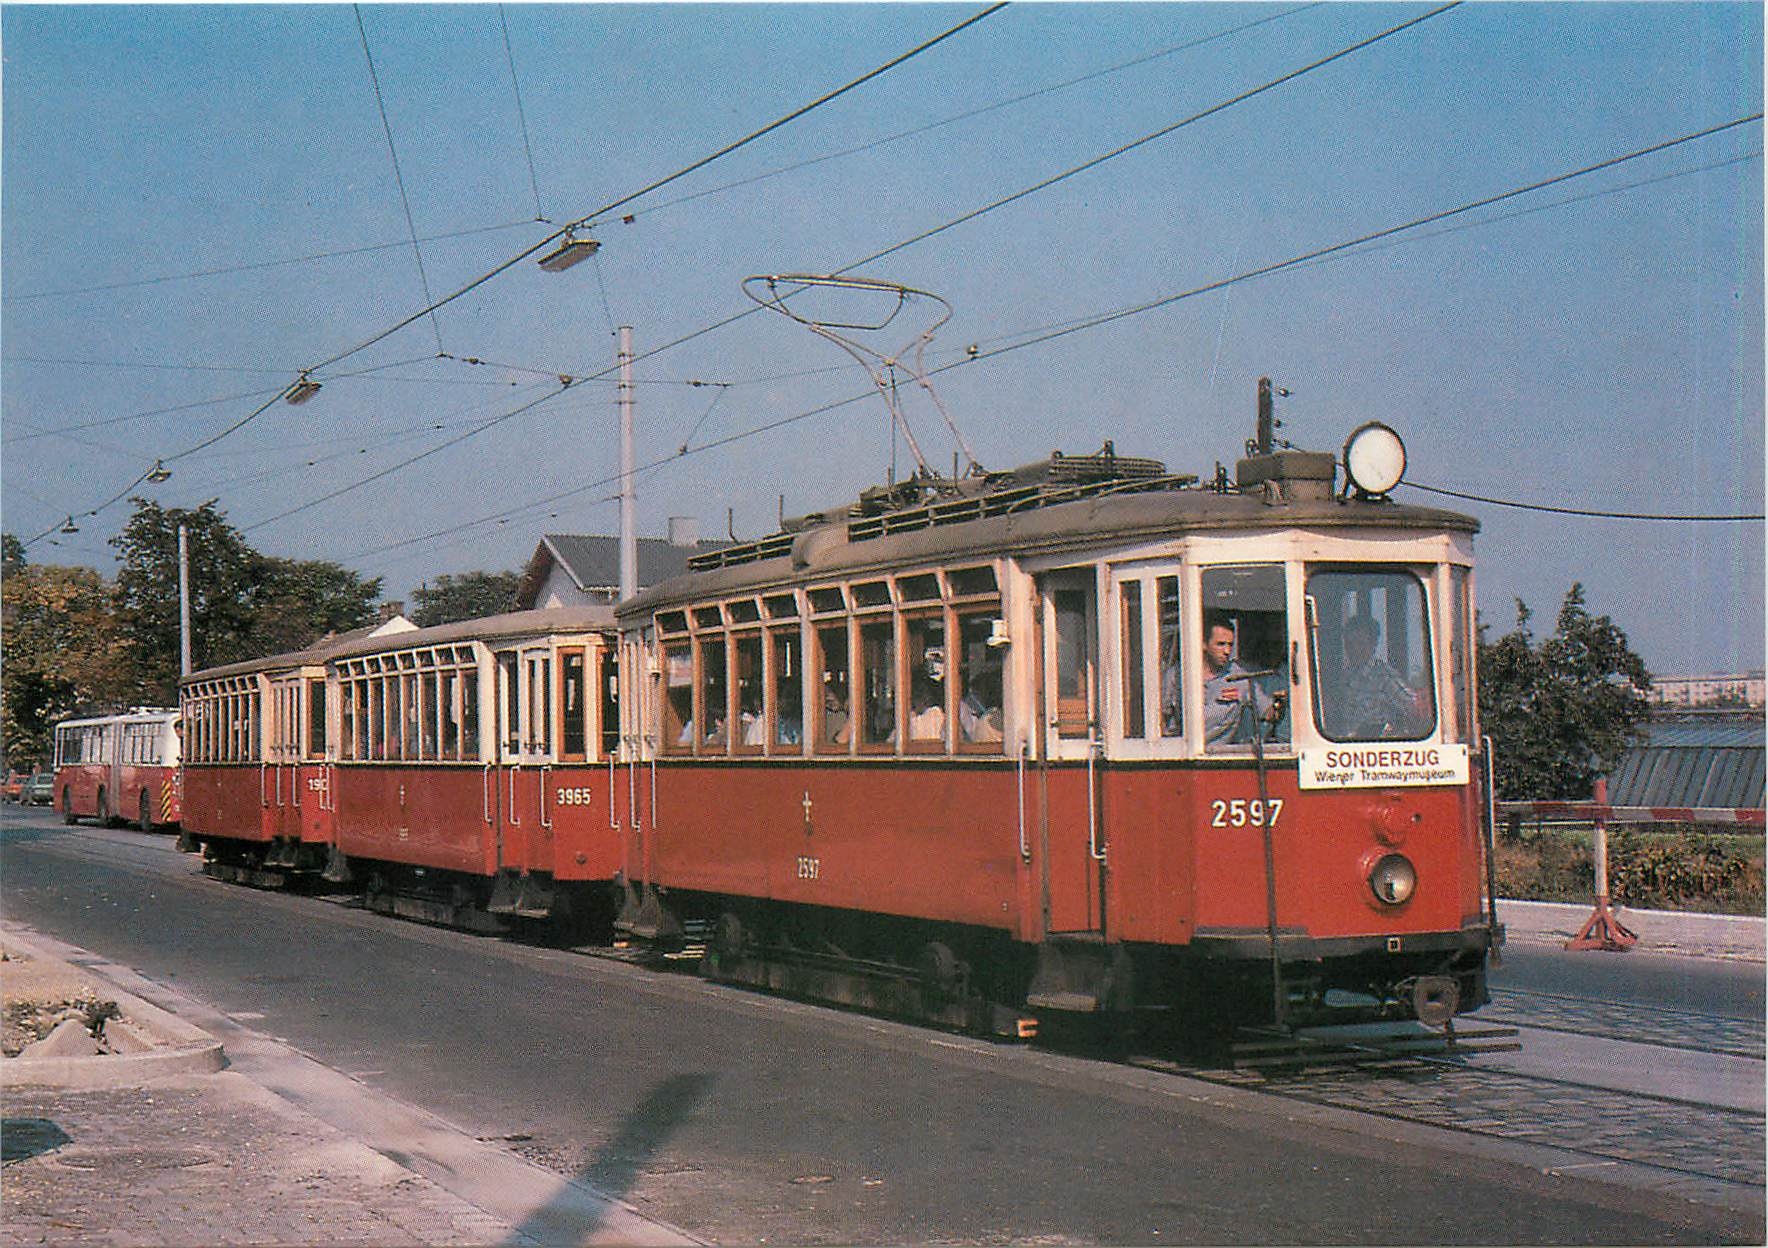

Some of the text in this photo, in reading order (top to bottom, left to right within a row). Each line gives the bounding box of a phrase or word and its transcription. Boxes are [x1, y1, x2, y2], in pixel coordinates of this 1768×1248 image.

[1326, 750, 1440, 768] SONDERZUG
[1314, 768, 1456, 785] Wiener Tramwaymuseum
[556, 787, 592, 805] 3965
[1211, 799, 1284, 828] 2597
